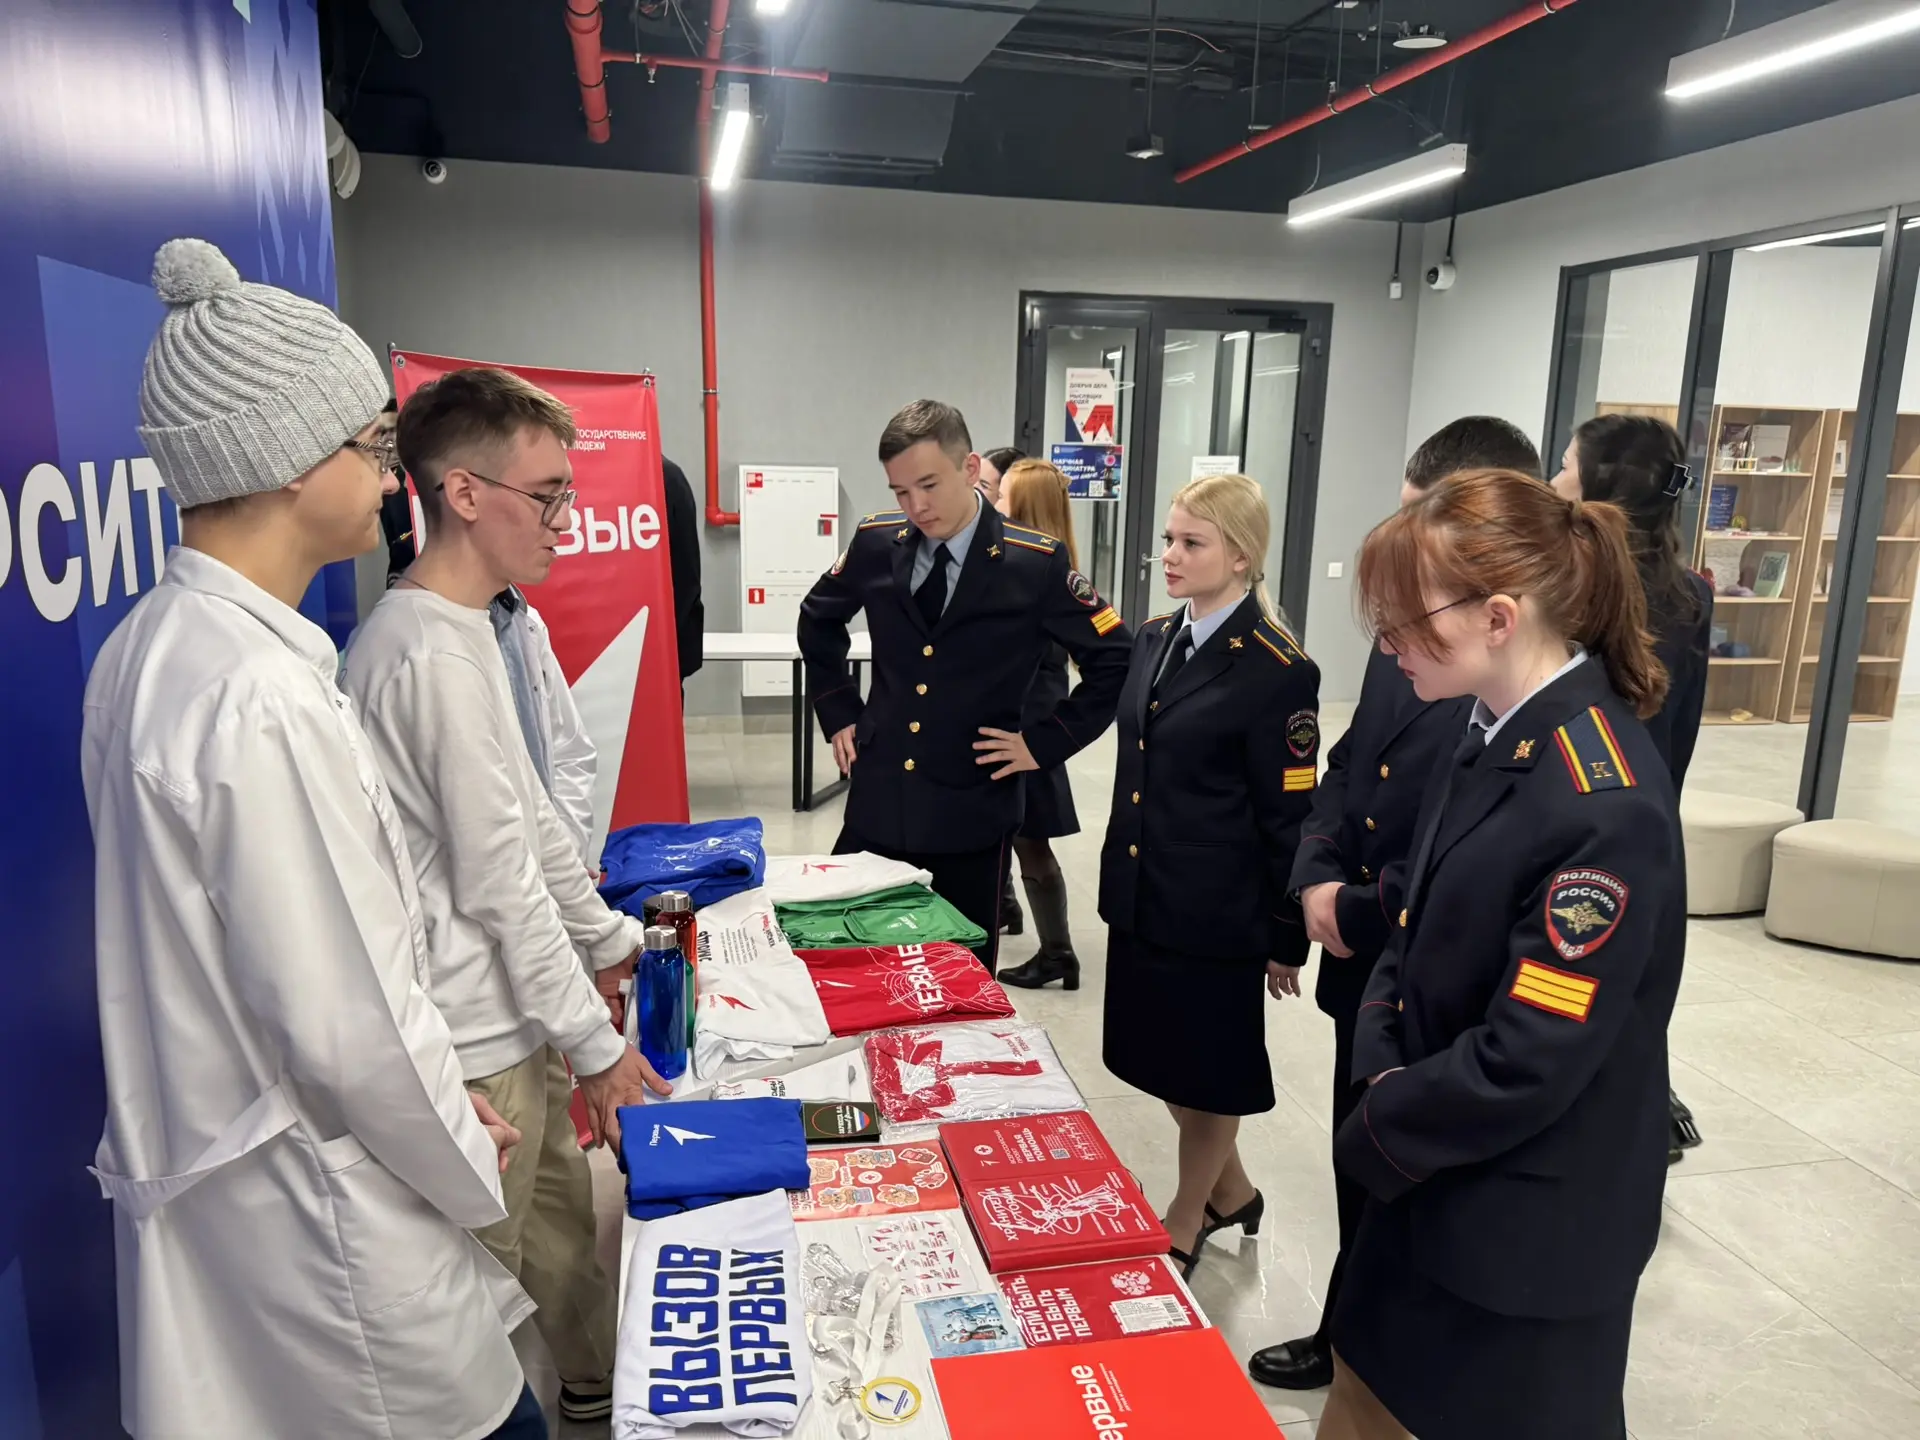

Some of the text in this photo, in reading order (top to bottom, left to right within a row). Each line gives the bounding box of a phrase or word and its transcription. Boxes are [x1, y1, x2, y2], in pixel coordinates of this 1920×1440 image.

[0, 457, 184, 622] СИТ
[1556, 887, 1616, 911] РОССИЯ
[1557, 871, 1625, 898] ПОЛИЦИЯ
[1558, 940, 1585, 957] МВД
[1013, 1134, 1036, 1162] ПЕРВАЯ
[1023, 1127, 1047, 1162] ПОМОЩЬ
[648, 1244, 724, 1416] ВЫЗОВ
[728, 1248, 798, 1406] ПЕРВЫХ
[1022, 1310, 1053, 1343] ЕСЛИ
[1036, 1289, 1073, 1340] ТО БЫТЬ
[1054, 1287, 1094, 1338] ПЕРВЫМ
[1070, 1364, 1129, 1440] ервые
